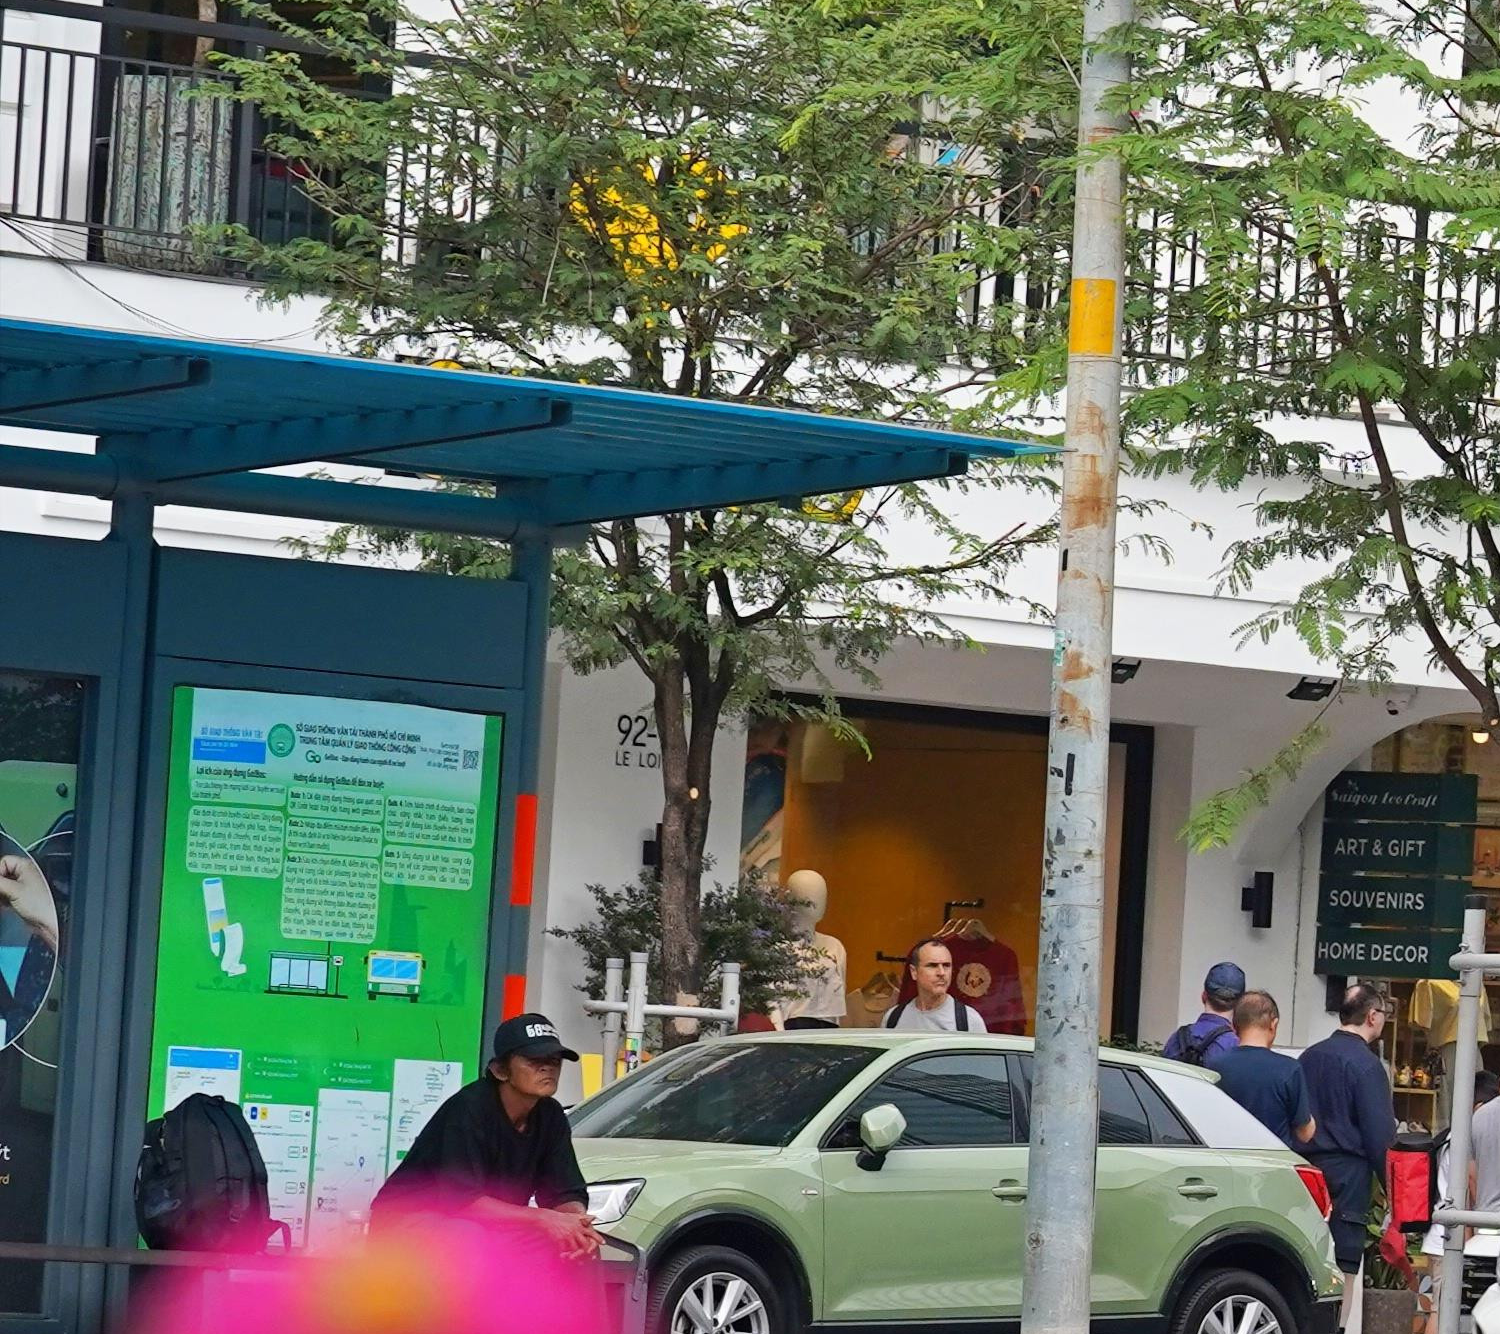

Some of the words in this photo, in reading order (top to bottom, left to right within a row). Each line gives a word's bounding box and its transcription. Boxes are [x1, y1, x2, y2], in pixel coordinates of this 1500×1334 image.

[616, 751, 630, 766] LE
[1334, 838, 1368, 856] ART
[1371, 839, 1383, 856] &
[1387, 839, 1426, 857] GIFT
[1329, 889, 1425, 910] SOUVENIRS
[1317, 941, 1366, 961] HOME
[1370, 943, 1429, 963] DECOR
